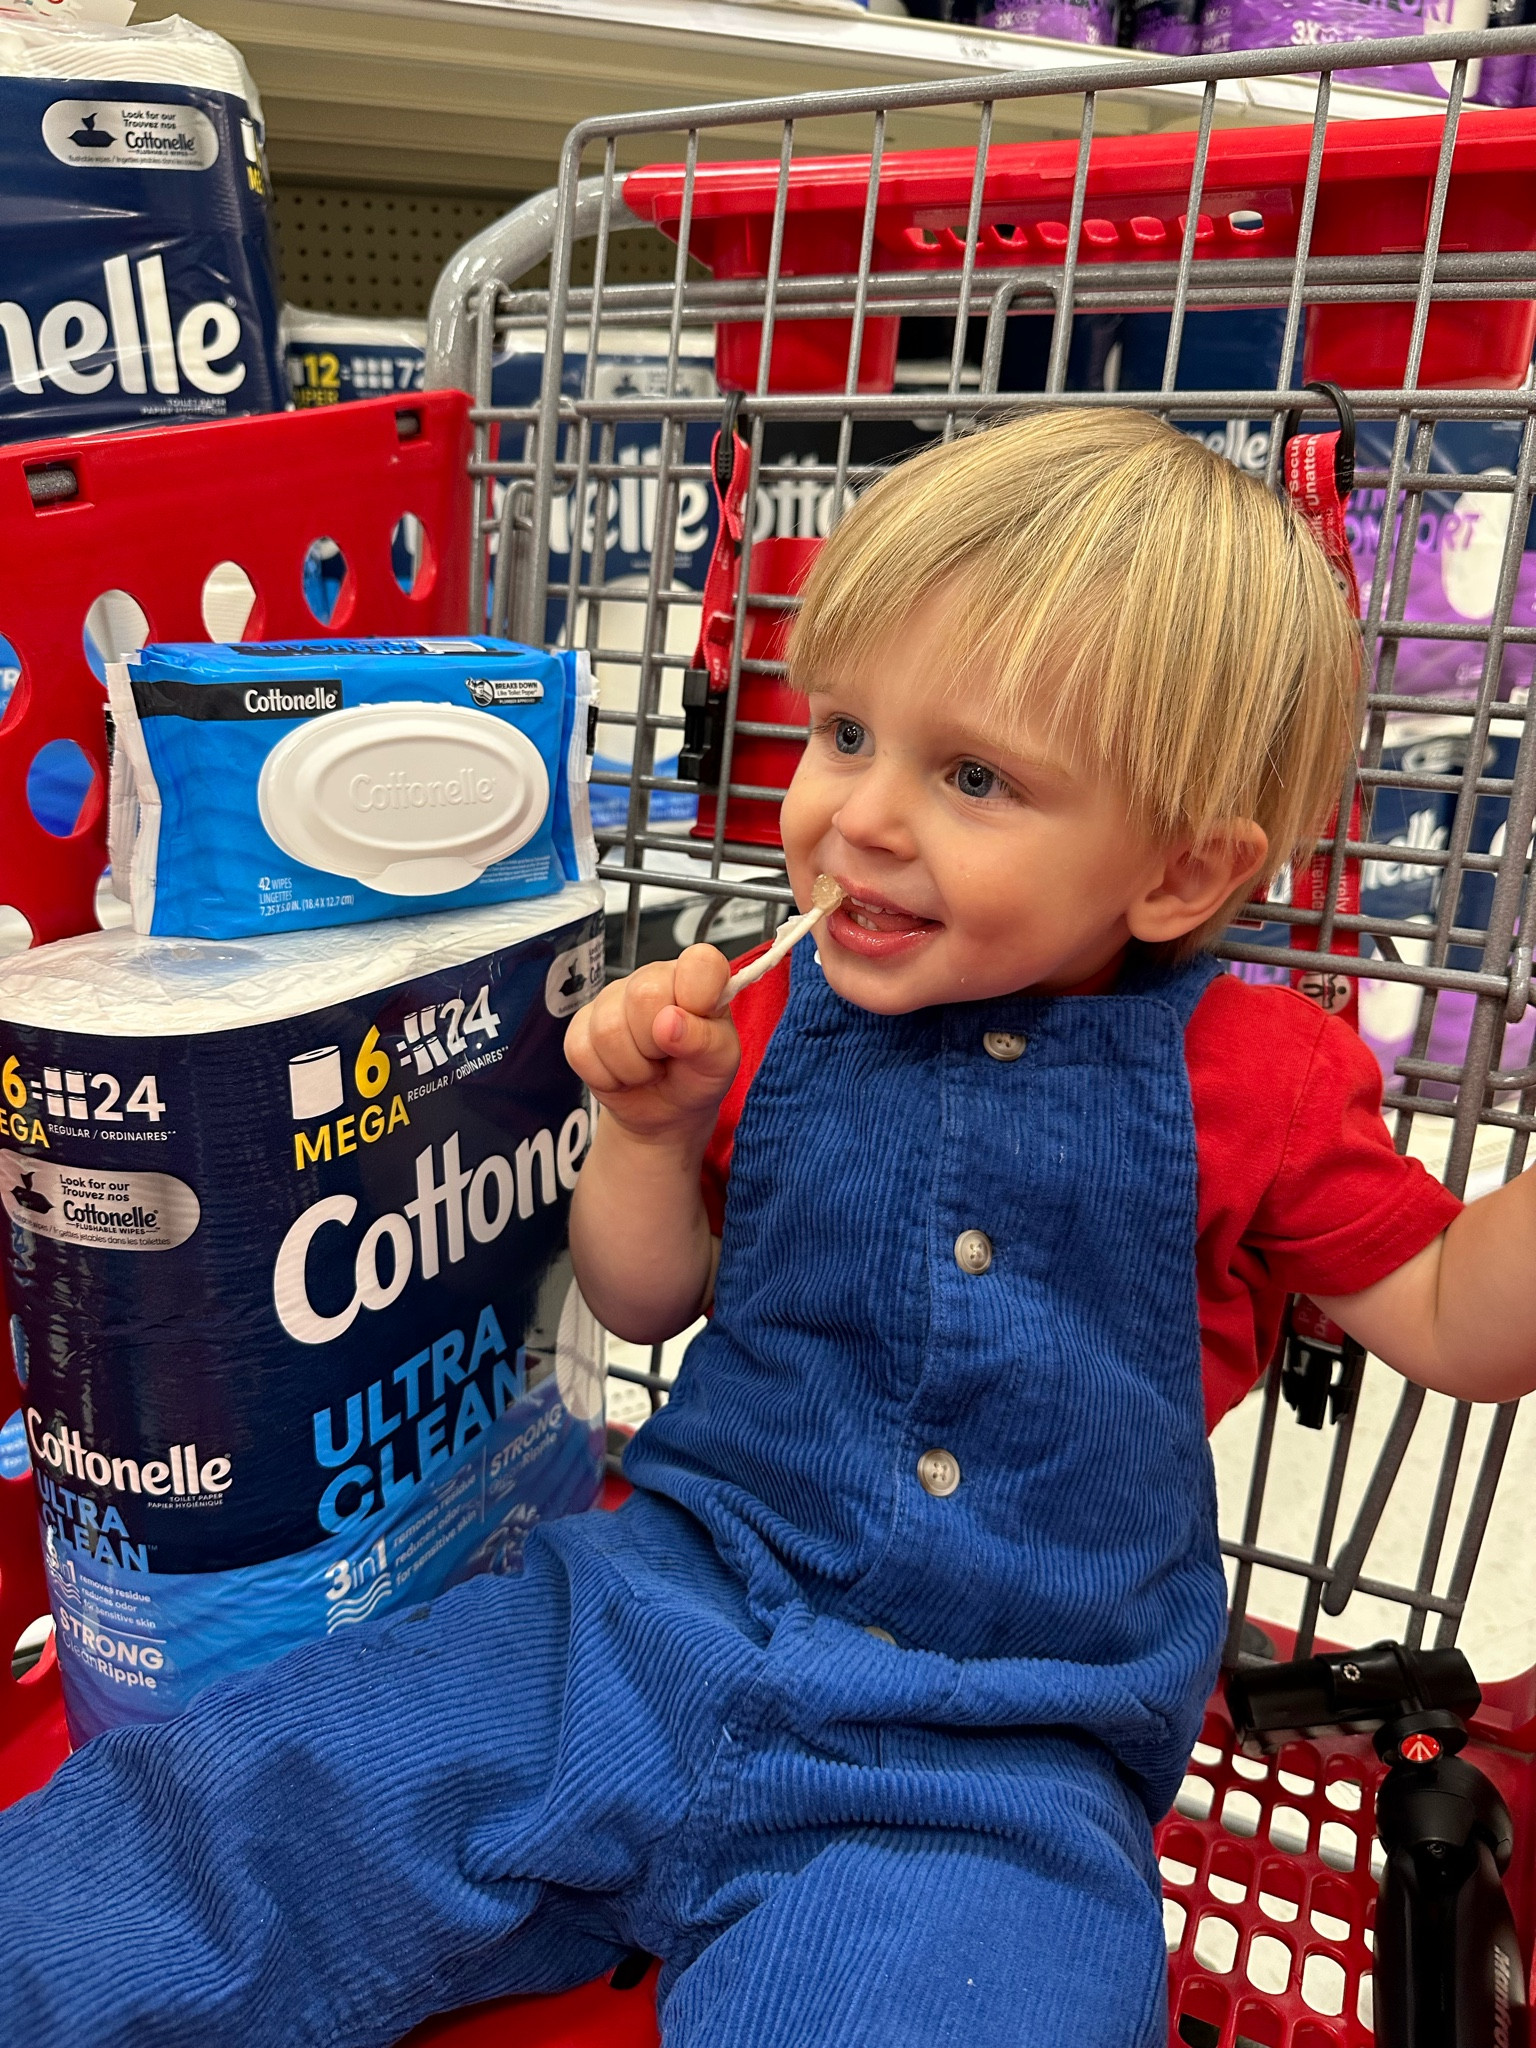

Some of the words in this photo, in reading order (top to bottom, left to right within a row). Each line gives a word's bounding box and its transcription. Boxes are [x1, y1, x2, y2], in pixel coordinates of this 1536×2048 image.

[122, 110, 143, 119] Look
[146, 111, 159, 119] for
[123, 119, 159, 129] Trouvez
[160, 122, 177, 130] nos
[125, 131, 195, 151] Cottonelle
[303, 352, 341, 388] 12
[244, 686, 338, 714] Cottonelle
[495, 682, 518, 690] BREAKS
[350, 768, 495, 813] Cottonelle
[258, 876, 271, 891] 42
[271, 877, 293, 890] WIPES
[259, 889, 293, 905] LINGETTES
[260, 904, 276, 916] 7.25
[354, 1024, 391, 1099] 6
[439, 984, 501, 1057] 24
[2, 1054, 28, 1109] 6
[90, 1073, 167, 1122] 24
[48, 1123, 91, 1139] REGULAR
[294, 1094, 411, 1171] MEGA
[407, 1075, 449, 1103] REGULAR
[59, 1174, 87, 1188] Look
[88, 1178, 107, 1190] for
[109, 1182, 130, 1192] our
[61, 1185, 105, 1201] Trouvez
[107, 1192, 130, 1202] nos
[63, 1199, 158, 1229] Cottonelle
[75, 1222, 118, 1234] FLUSHABLE
[119, 1227, 146, 1235] WIPES
[107, 1236, 126, 1245] dans
[313, 1304, 508, 1468] ULTRA
[27, 1406, 233, 1496] Cottonelle
[318, 1344, 528, 1534] CLEAN
[490, 1403, 562, 1477] STRONG
[36, 1468, 131, 1538] ULTRA
[147, 1501, 174, 1509] PAPIER
[169, 1493, 198, 1503] TOILET
[198, 1492, 224, 1502] PAPER
[396, 1527, 437, 1566] reduces
[437, 1505, 462, 1531] odor
[396, 1568, 413, 1588] for
[412, 1529, 456, 1573] sensitive
[457, 1509, 477, 1532] skin
[325, 1534, 388, 1601] 3in1
[393, 1506, 439, 1548] removes
[79, 1574, 114, 1594] removes
[115, 1588, 151, 1603] residue
[81, 1587, 114, 1606] reduces
[115, 1600, 137, 1613] odor
[96, 1604, 134, 1624] sensitive
[136, 1617, 156, 1629] skin
[59, 1606, 164, 1670] STRONG
[62, 1631, 157, 1690] CleanRipple
[1493, 1944, 1511, 2048] Manfro
